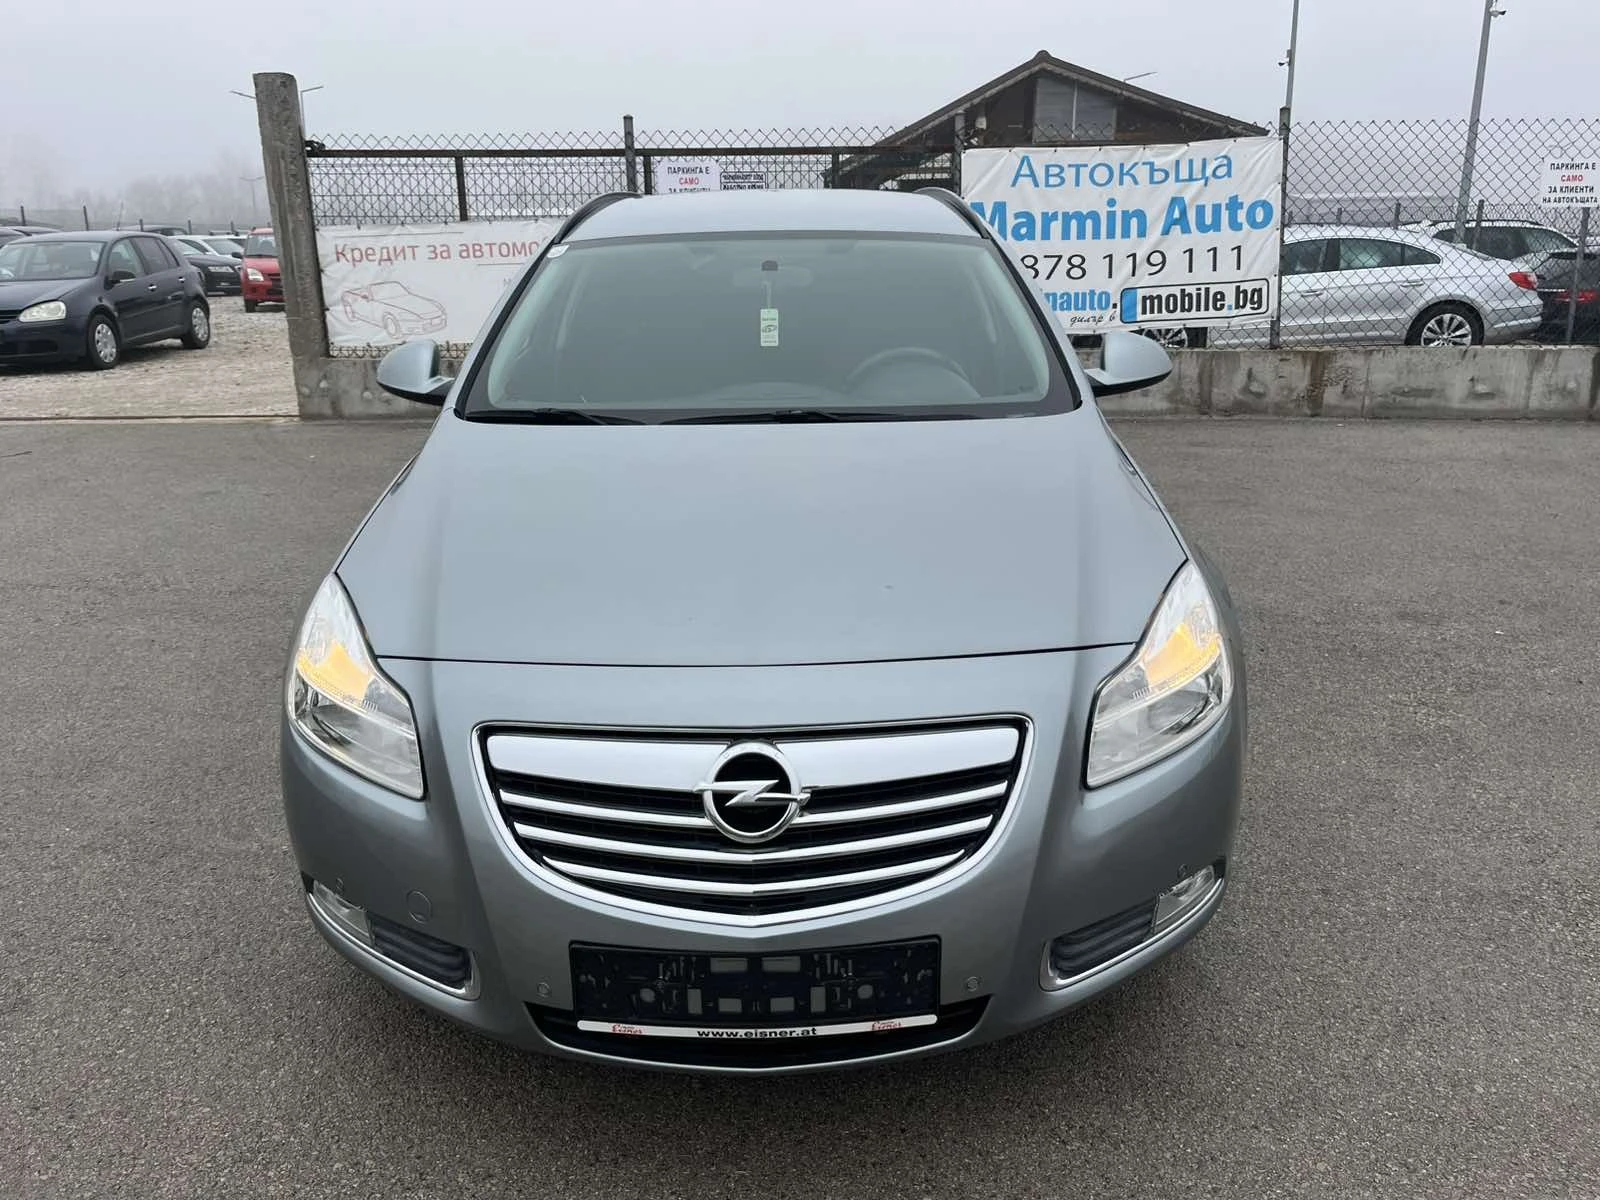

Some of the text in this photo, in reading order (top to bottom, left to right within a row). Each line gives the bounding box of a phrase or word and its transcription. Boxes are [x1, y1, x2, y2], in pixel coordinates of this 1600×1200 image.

[667, 166, 710, 175] ПАРКИНГА Е
[1011, 154, 1233, 188] Автокъща
[1591, 162, 1596, 170] Е
[679, 176, 700, 185] САМО
[1560, 174, 1584, 182] САМО
[1553, 196, 1598, 204] АВТОКЪЩАТА
[970, 194, 1274, 242] Marmin Auto
[334, 243, 419, 268] Кредит
[427, 243, 452, 260] за
[1103, 250, 1167, 279] 119
[1183, 245, 1243, 274] 111
[1141, 284, 1263, 315] mobile.bg
[697, 1027, 817, 1039] www.eisner.at
